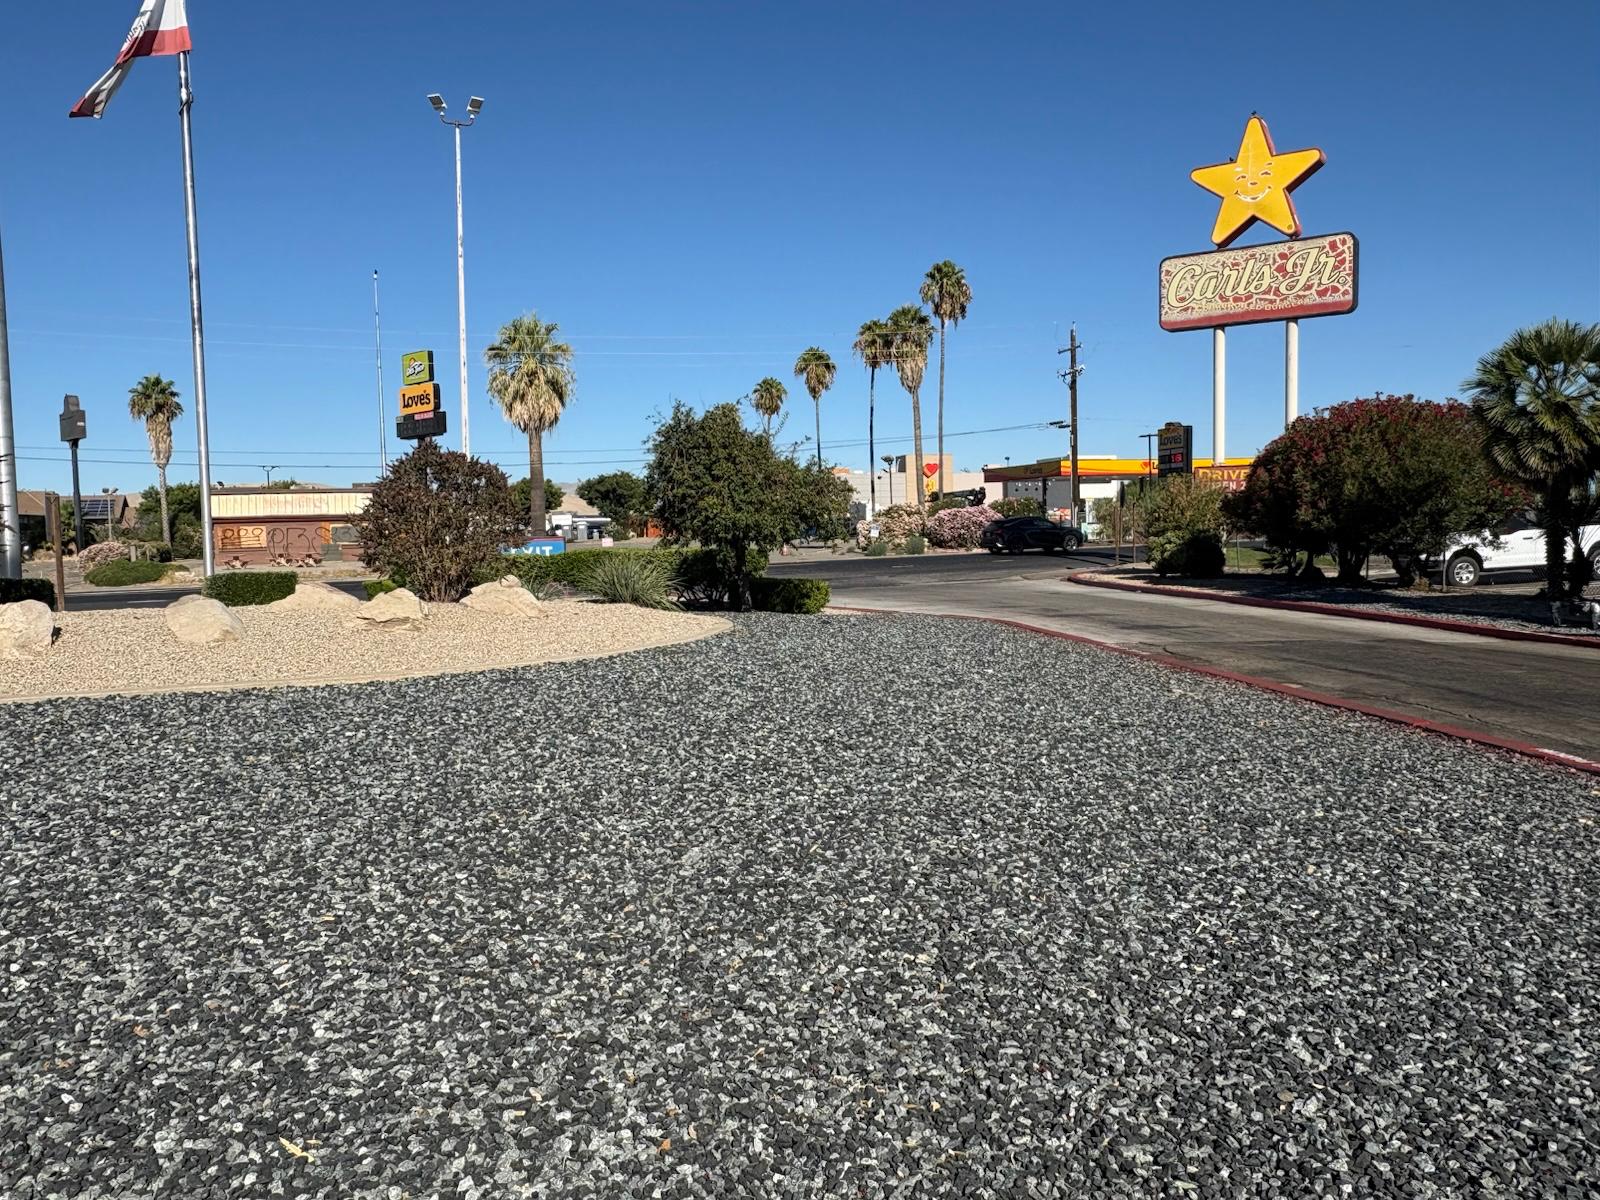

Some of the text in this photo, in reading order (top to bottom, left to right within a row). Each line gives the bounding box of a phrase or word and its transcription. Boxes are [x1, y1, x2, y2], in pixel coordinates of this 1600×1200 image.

[1167, 246, 1348, 308] Carl's Jr.
[402, 389, 430, 408] Love's
